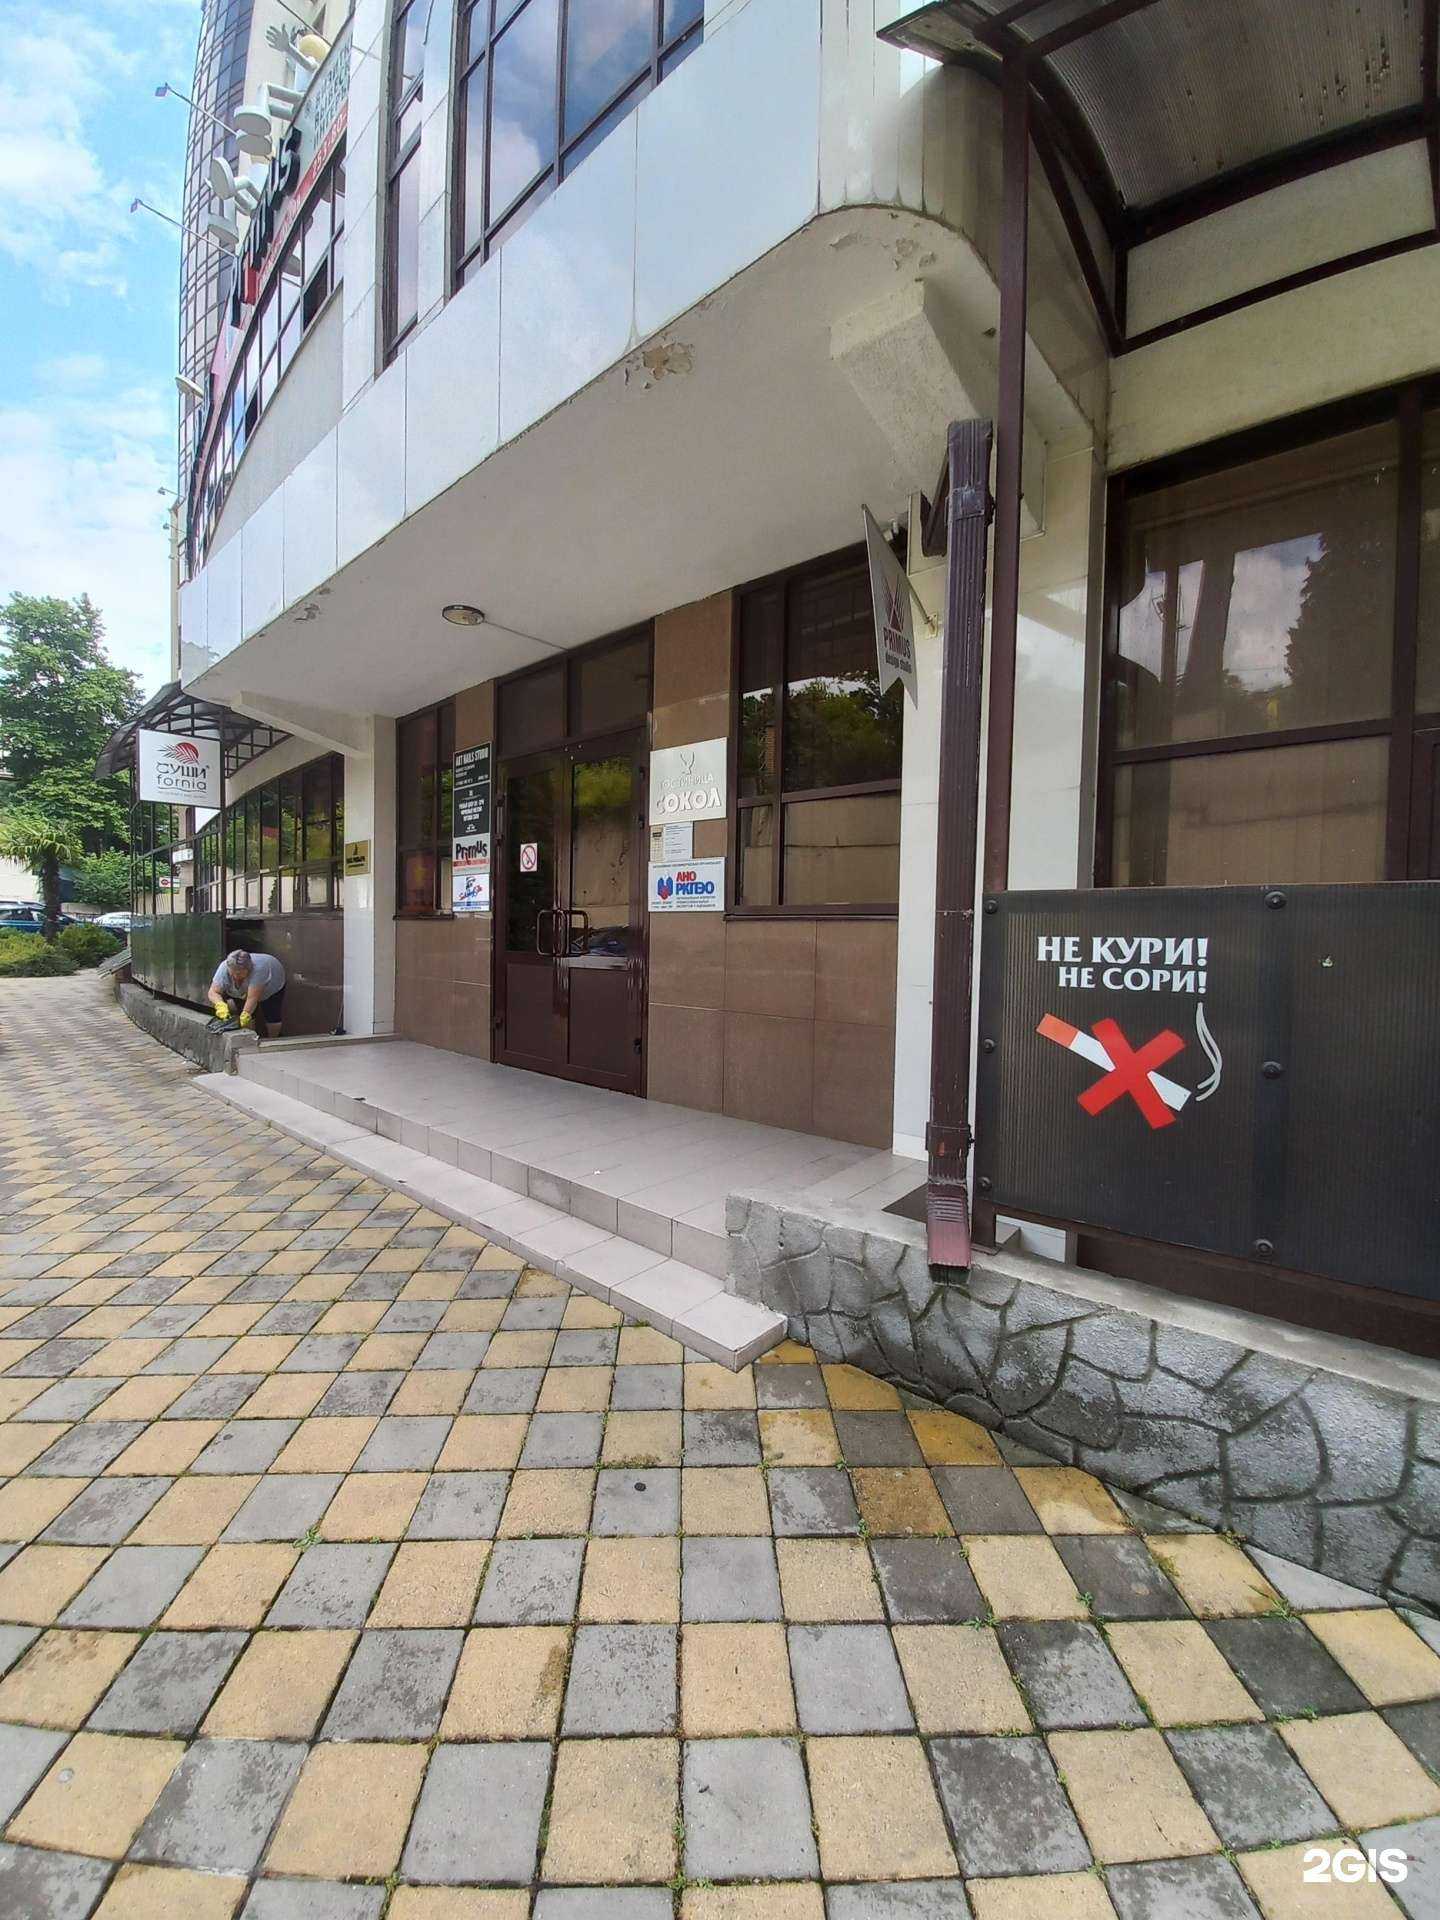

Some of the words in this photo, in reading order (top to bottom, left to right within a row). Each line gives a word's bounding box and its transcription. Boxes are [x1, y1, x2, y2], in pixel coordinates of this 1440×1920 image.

[883, 627, 911, 659] PRIMUS
[156, 761, 207, 779] СУШИ
[156, 774, 207, 790] fornia
[656, 787, 722, 815] СОКОЛ
[676, 871, 697, 883] АНО
[1036, 936, 1082, 963] НЕ
[1091, 936, 1209, 966] КУРИ!
[1057, 967, 1096, 989] НЕ
[1102, 967, 1208, 995] СОРИ!
